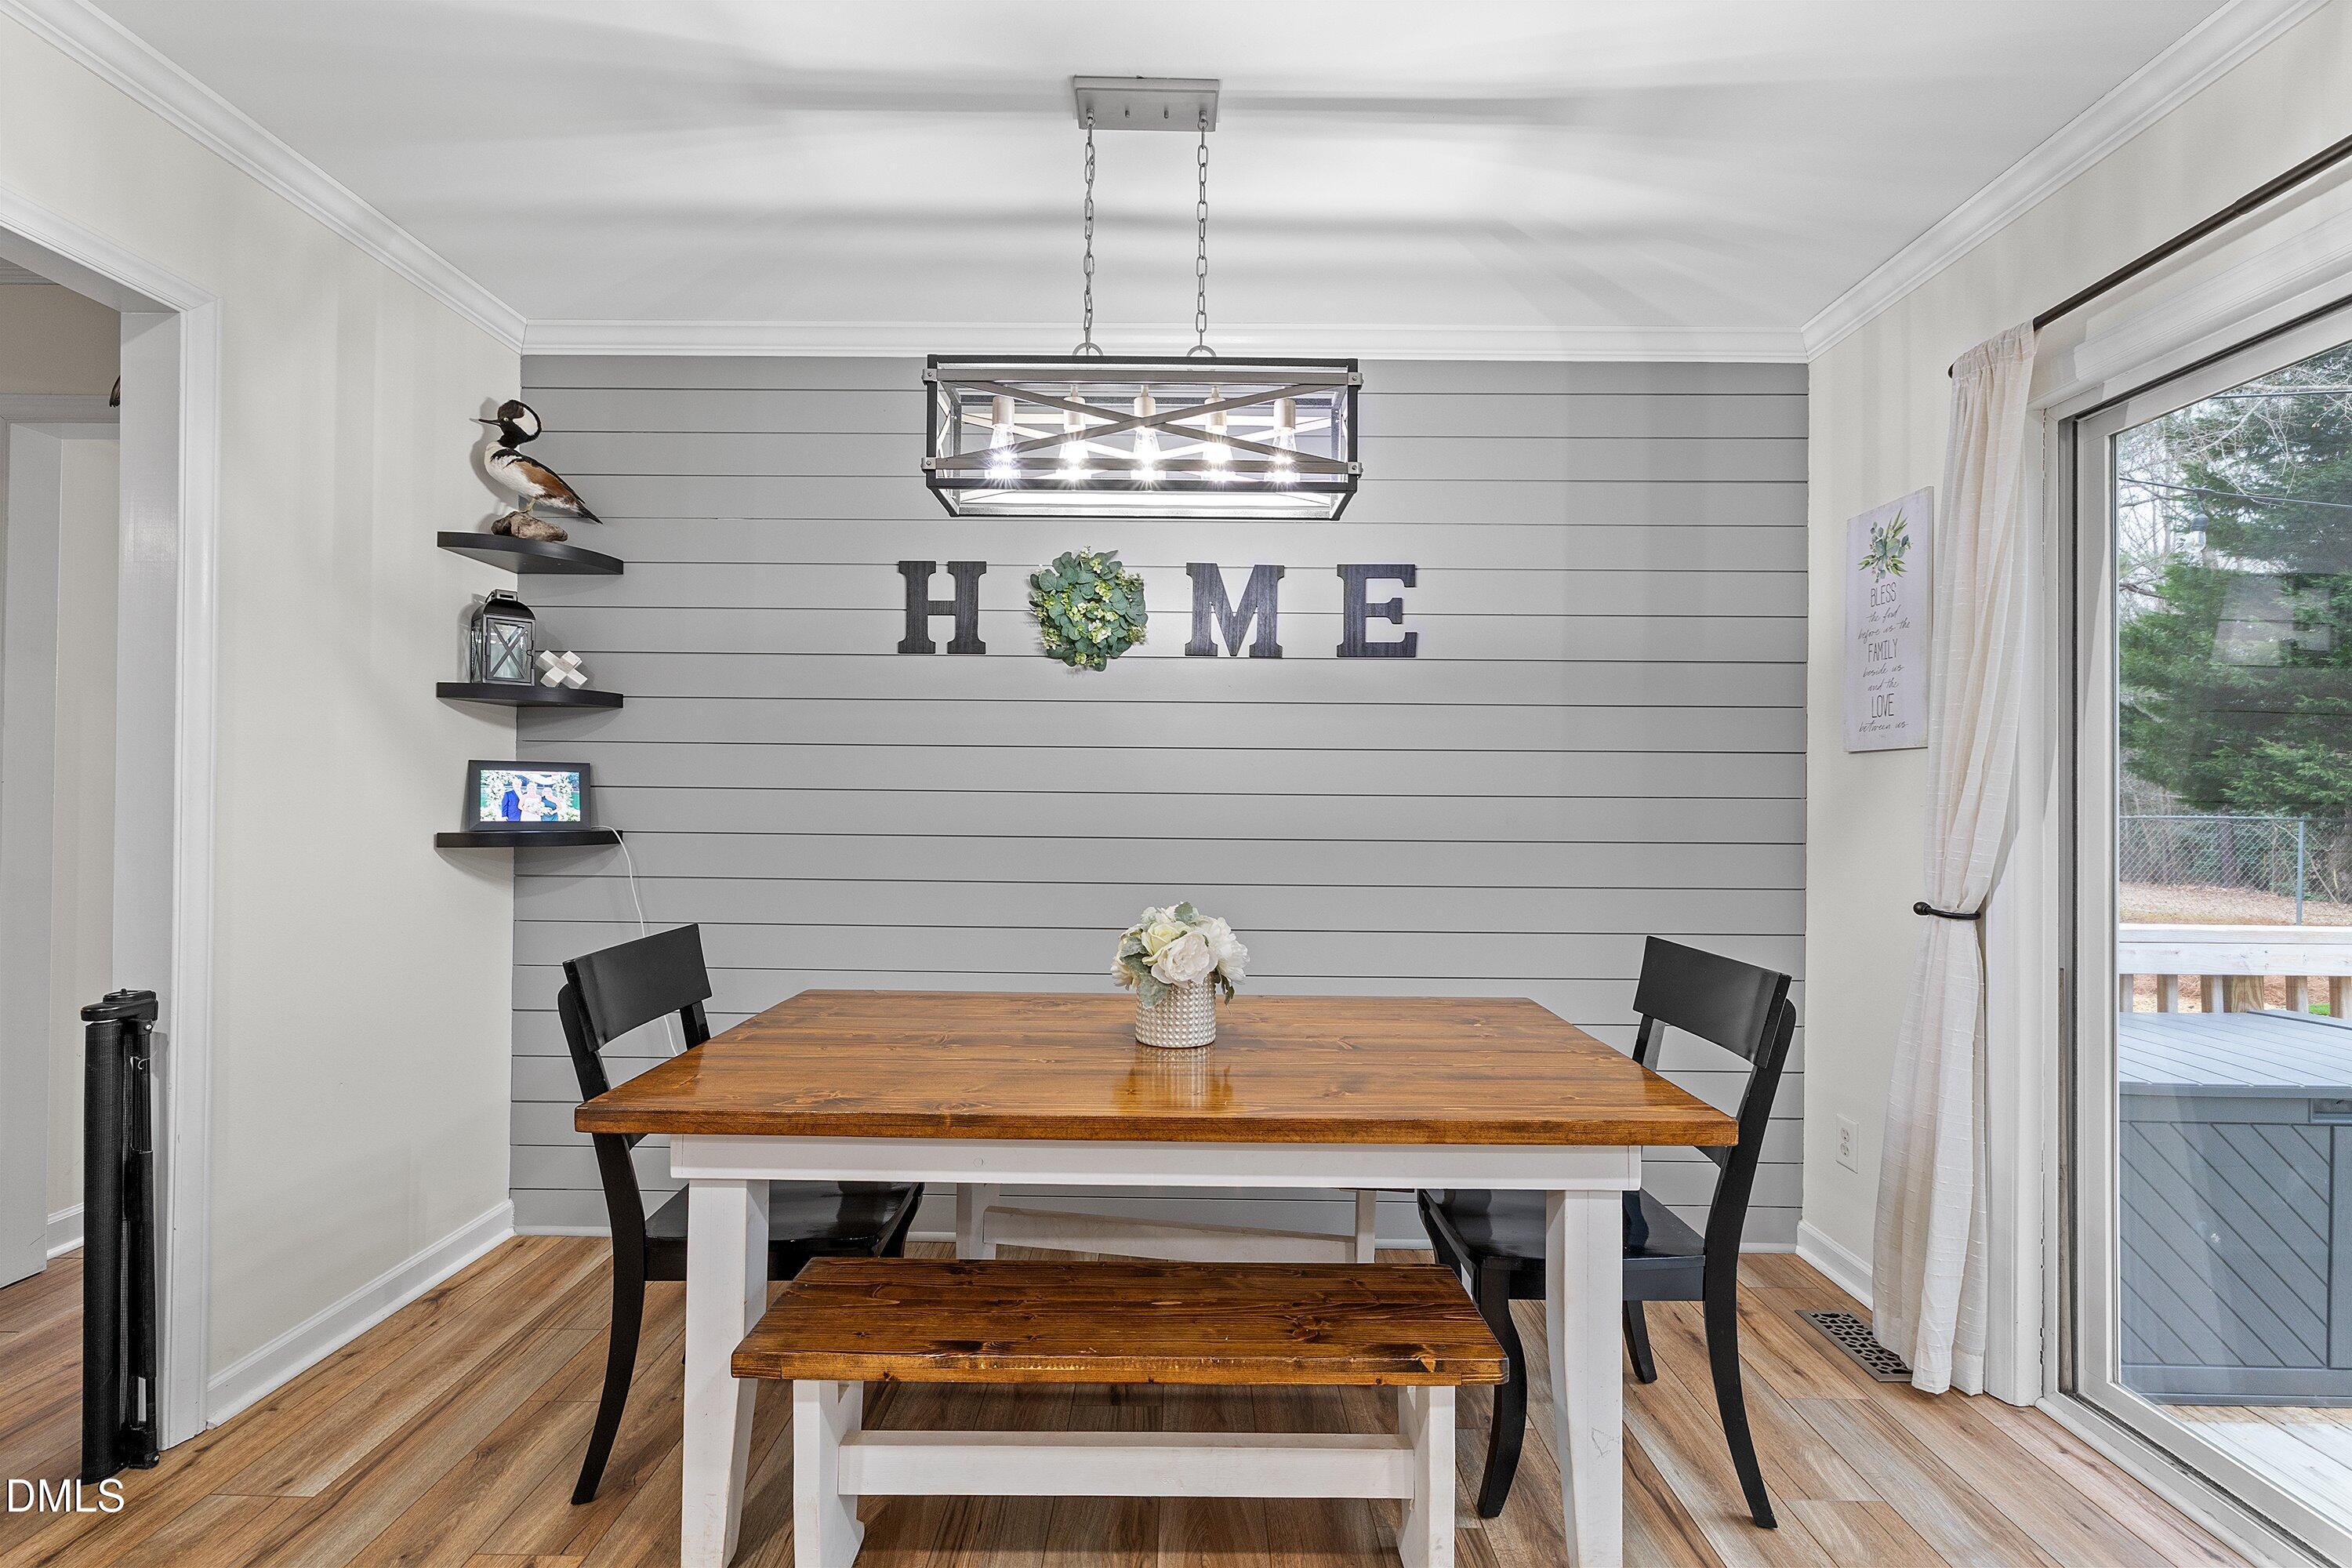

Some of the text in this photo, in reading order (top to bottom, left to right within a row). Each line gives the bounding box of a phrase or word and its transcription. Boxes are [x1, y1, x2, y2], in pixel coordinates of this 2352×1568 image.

[1870, 582, 1896, 607] BLESS
[898, 561, 1417, 658] HME
[1866, 612, 1881, 623] the
[1857, 617, 1911, 644] before us the
[1867, 638, 1898, 663] FAMILY
[1863, 662, 1888, 677] beside
[1867, 677, 1900, 691] and the
[1871, 693, 1894, 718] LOVE
[1859, 720, 1891, 732] between
